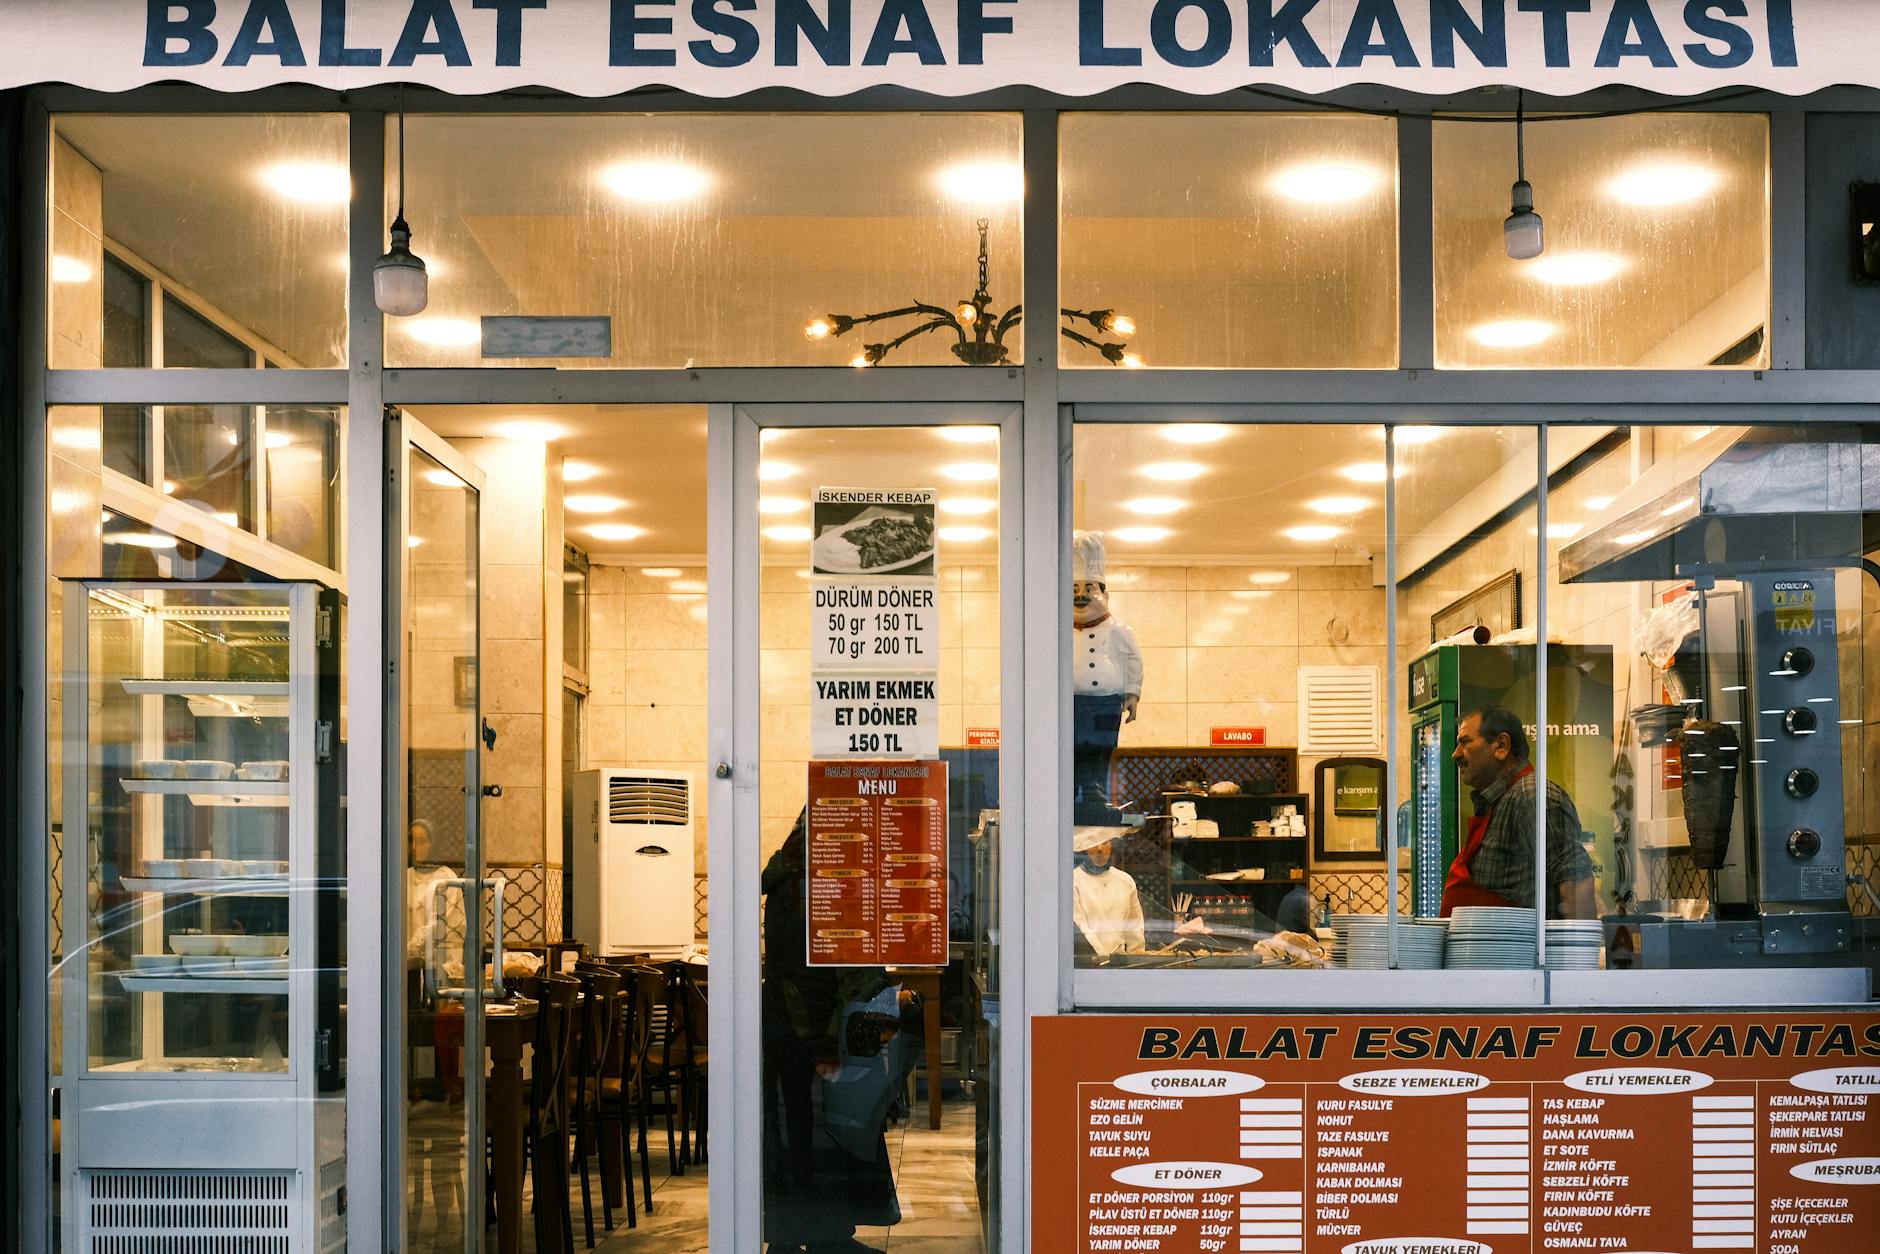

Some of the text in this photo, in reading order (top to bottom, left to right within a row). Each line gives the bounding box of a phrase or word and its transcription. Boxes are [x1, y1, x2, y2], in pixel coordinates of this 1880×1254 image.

[143, 0, 1798, 68] BALAT ESNAF LOKANTASI
[820, 493, 930, 502] İSKENDER KEBAP
[817, 586, 933, 607] DÜRÜM DÖNER
[829, 614, 922, 635] 50 gr 150 TL
[829, 637, 922, 658] 70 gr 200 TL
[817, 681, 934, 699] YARIM EKMEK
[836, 703, 917, 725] ET DÖNER
[1223, 732, 1252, 740] LAVABO
[1562, 723, 1600, 736] ama
[849, 734, 902, 751] 150 TL
[858, 780, 896, 794] MENU
[1137, 1027, 1337, 1060] BALAT
[1351, 1026, 1562, 1060] ESNAF
[1152, 1078, 1226, 1089] ÇORBALAR
[1352, 1075, 1480, 1088] SEBZE YEMEKLERİ
[1586, 1073, 1692, 1086] ETLİ YEMEKLER
[1090, 1097, 1183, 1110] SÜZME MERCİMEK
[1317, 1100, 1393, 1110] KURU FASULYE
[1543, 1099, 1605, 1109] TAS KEBAP
[1770, 1095, 1867, 1108] KEMALPAŞA TATLISI
[1090, 1112, 1143, 1125] EZO GELİN
[1317, 1115, 1353, 1126] NOHUT
[1543, 1114, 1599, 1126] HAŞLAMA
[1769, 1111, 1865, 1124] ŞEKERPARE TATLISI
[1089, 1131, 1151, 1141] TAVUK SUYU
[1317, 1131, 1389, 1142] TAZE FASULYE
[1543, 1129, 1634, 1139] DANA KAVURMA
[1770, 1125, 1843, 1138] İRMİK HELVASI
[1090, 1146, 1149, 1159] KELLE PAÇA
[1318, 1147, 1363, 1157] ISPANAK
[1544, 1145, 1589, 1155] ET SOTE
[1770, 1141, 1837, 1155] FIRIN SÜTLAÇ
[1543, 1158, 1616, 1171] İZMİR KÖFTE
[1175, 1168, 1221, 1178] DÖNER
[1317, 1177, 1402, 1188] KABAK DOLMASI
[1543, 1174, 1629, 1186] SEBZELİ KÖFTE
[1090, 1191, 1234, 1204] ET DÖNER PORSİYON 110gr
[1316, 1191, 1398, 1203] BİBER DOLMASI
[1544, 1189, 1614, 1201] FIRIN KÖFTE
[1543, 1204, 1651, 1216] KADINBUDU KÖFTE
[1771, 1197, 1848, 1210] ŞİŞE İÇECEKLER
[1089, 1207, 1233, 1221] PİLAV ÜSTÜ ET DÖNER 110gr
[1316, 1207, 1349, 1219] TÜRLÜ
[1771, 1214, 1797, 1223] KUTU
[1089, 1223, 1232, 1237] İSKENDER KEBAP 110gr
[1317, 1223, 1361, 1235] MÜCVER
[1544, 1220, 1583, 1234] GÜVEÇ
[1770, 1230, 1806, 1239] AYRAN
[1090, 1238, 1226, 1252] YARIM DÖNER 50gr
[1544, 1237, 1627, 1248] OSMANLI TAVA
[1770, 1245, 1799, 1254] SODA
